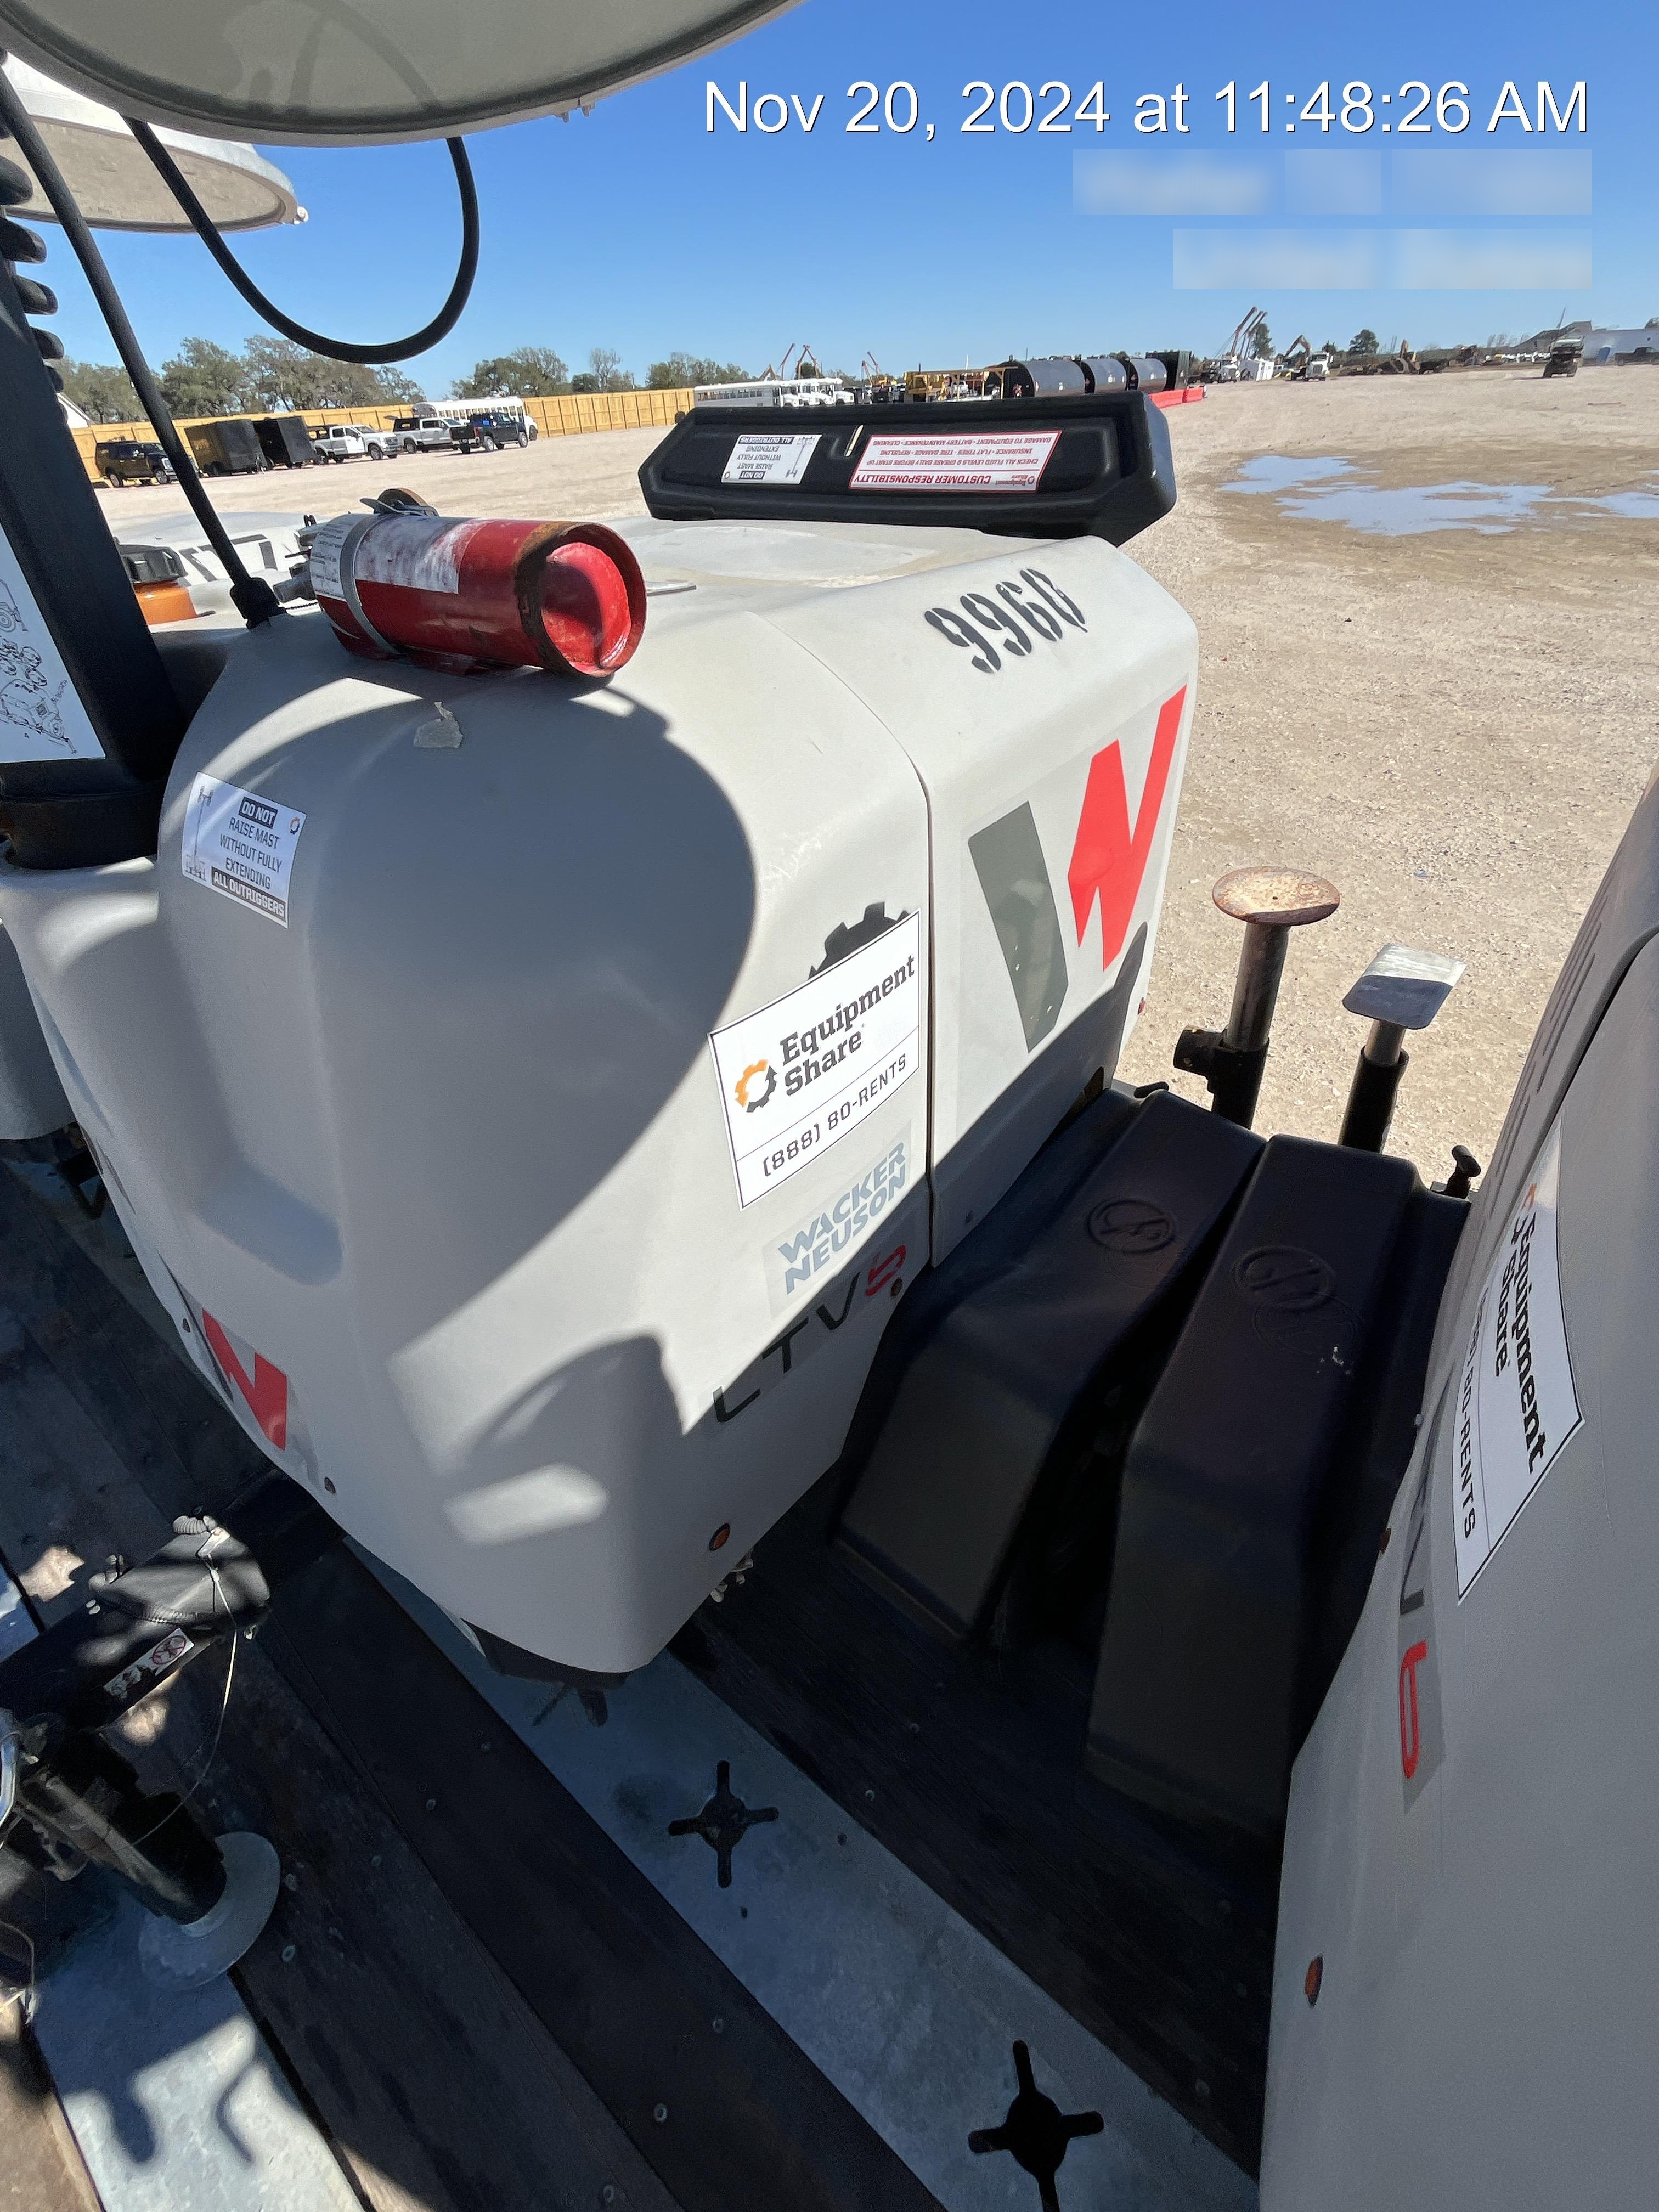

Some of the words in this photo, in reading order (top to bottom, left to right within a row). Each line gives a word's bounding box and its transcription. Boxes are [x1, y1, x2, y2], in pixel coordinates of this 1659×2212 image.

[854, 475, 933, 483] RESPONSIBILITY
[934, 475, 991, 484] CUSTOMER
[924, 568, 1088, 674] 9960
[220, 833, 258, 862] WITHOUT
[257, 852, 282, 873] FULLY
[229, 817, 255, 839] RAISE
[255, 828, 280, 849] MAST
[241, 801, 256, 817] DO
[256, 806, 275, 825] NOT
[213, 871, 228, 889] ALL
[229, 878, 285, 917] OUTRIGGERS
[226, 857, 271, 890] EXTENDING
[780, 953, 916, 1065] Equipment
[785, 1030, 862, 1097] Share
[763, 1126, 822, 1177] (888)
[827, 1052, 907, 1131] 80-RENTS
[778, 1142, 906, 1263] WACKER
[785, 1161, 906, 1295] NEUSON
[1494, 1250, 1518, 1378] Share
[1512, 1221, 1547, 1475] Equipment
[1458, 1370, 1478, 1540] 80-RENTS
